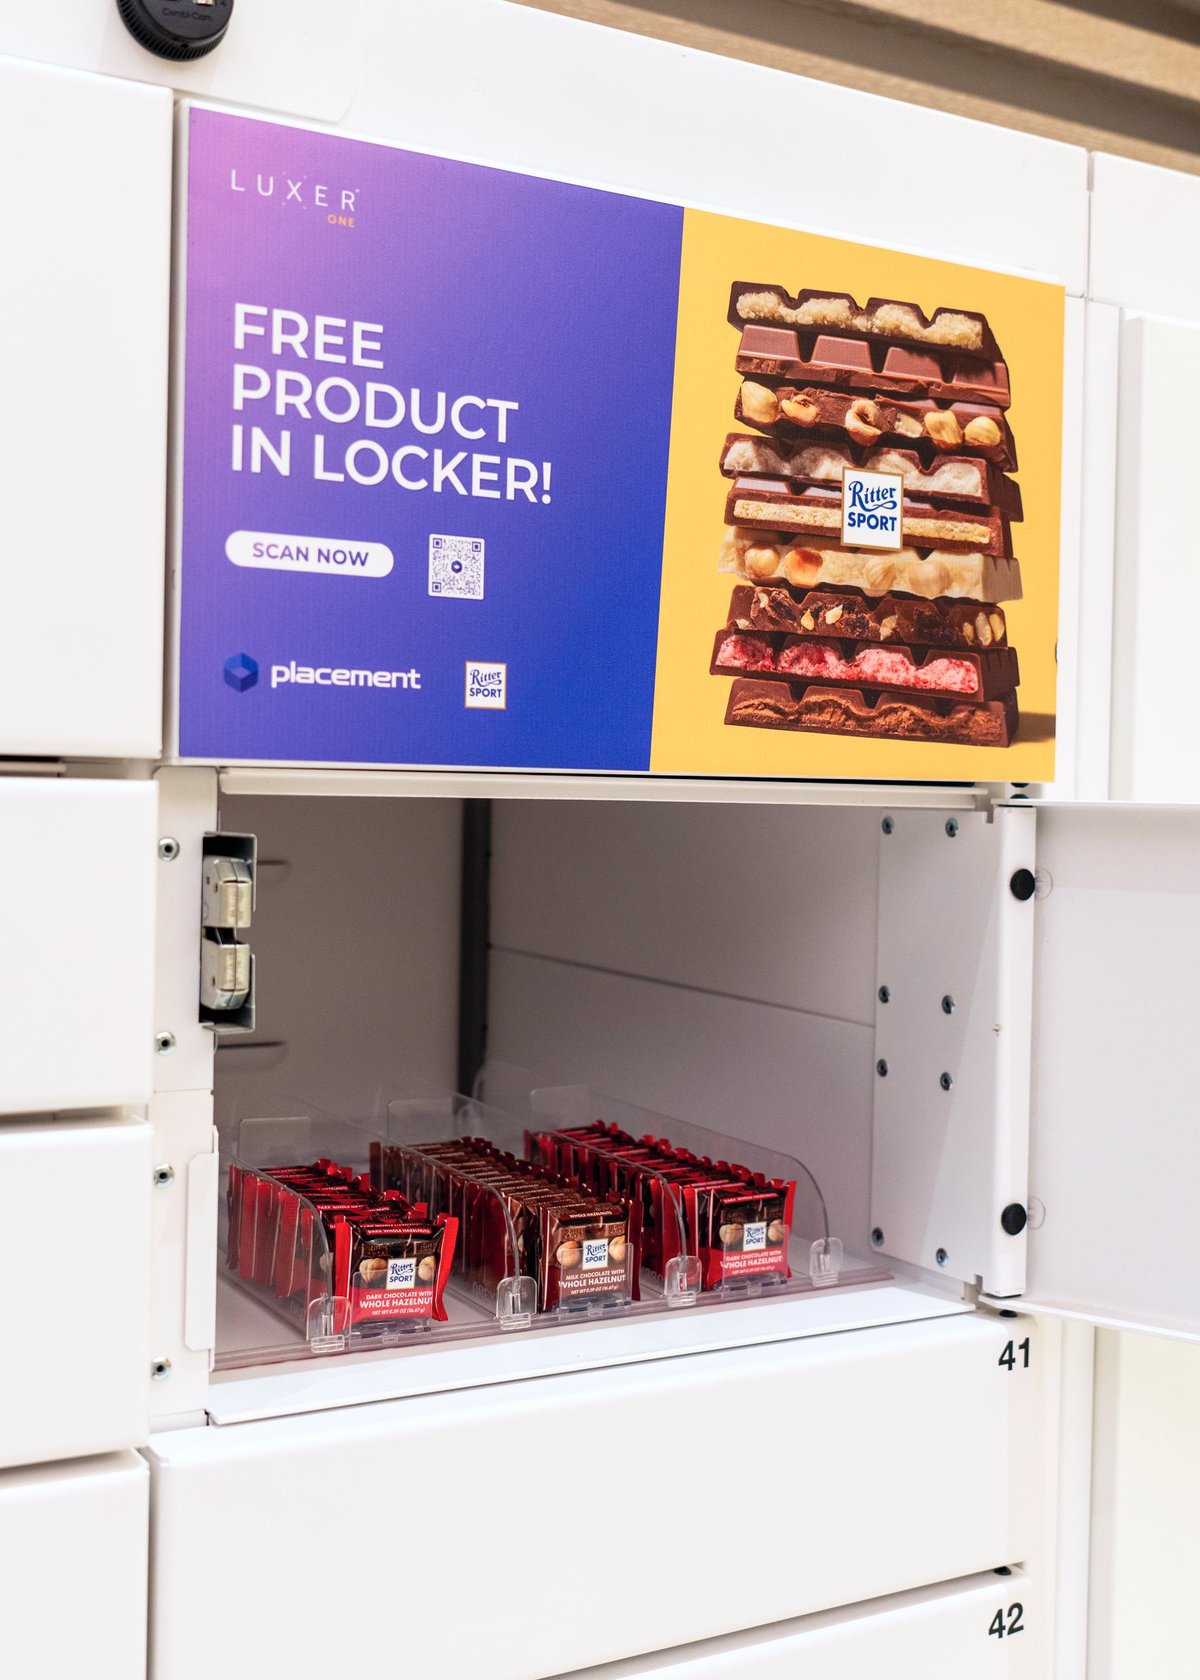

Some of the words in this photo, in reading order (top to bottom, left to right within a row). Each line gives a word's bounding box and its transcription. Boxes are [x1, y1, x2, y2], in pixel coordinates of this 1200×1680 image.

[231, 169, 356, 212] LUXER
[327, 213, 355, 228] ONE
[234, 302, 384, 369] FREE
[232, 363, 519, 444] PRODUCT
[231, 424, 291, 477] IN
[314, 434, 552, 505] LOCKER!
[848, 481, 897, 512] Ritter
[847, 511, 897, 531] SPORT
[252, 542, 309, 563] SCAN
[317, 548, 369, 567] NOW
[270, 660, 421, 690] placement
[469, 668, 502, 687] Ritter
[469, 687, 502, 699] SPORT
[745, 1236, 764, 1245] SPORT
[585, 1255, 606, 1264] SPORT
[720, 1259, 747, 1269] WHOLE
[389, 1263, 413, 1276] Ritter
[580, 1270, 610, 1279] CHOCOLATE
[389, 1275, 413, 1283] SPORT
[558, 1279, 587, 1289] WHOLE
[359, 1299, 391, 1308] WHOLE
[383, 1291, 417, 1299] CHOCOLATE
[998, 1337, 1031, 1371] 41
[988, 1601, 1024, 1639] 42
